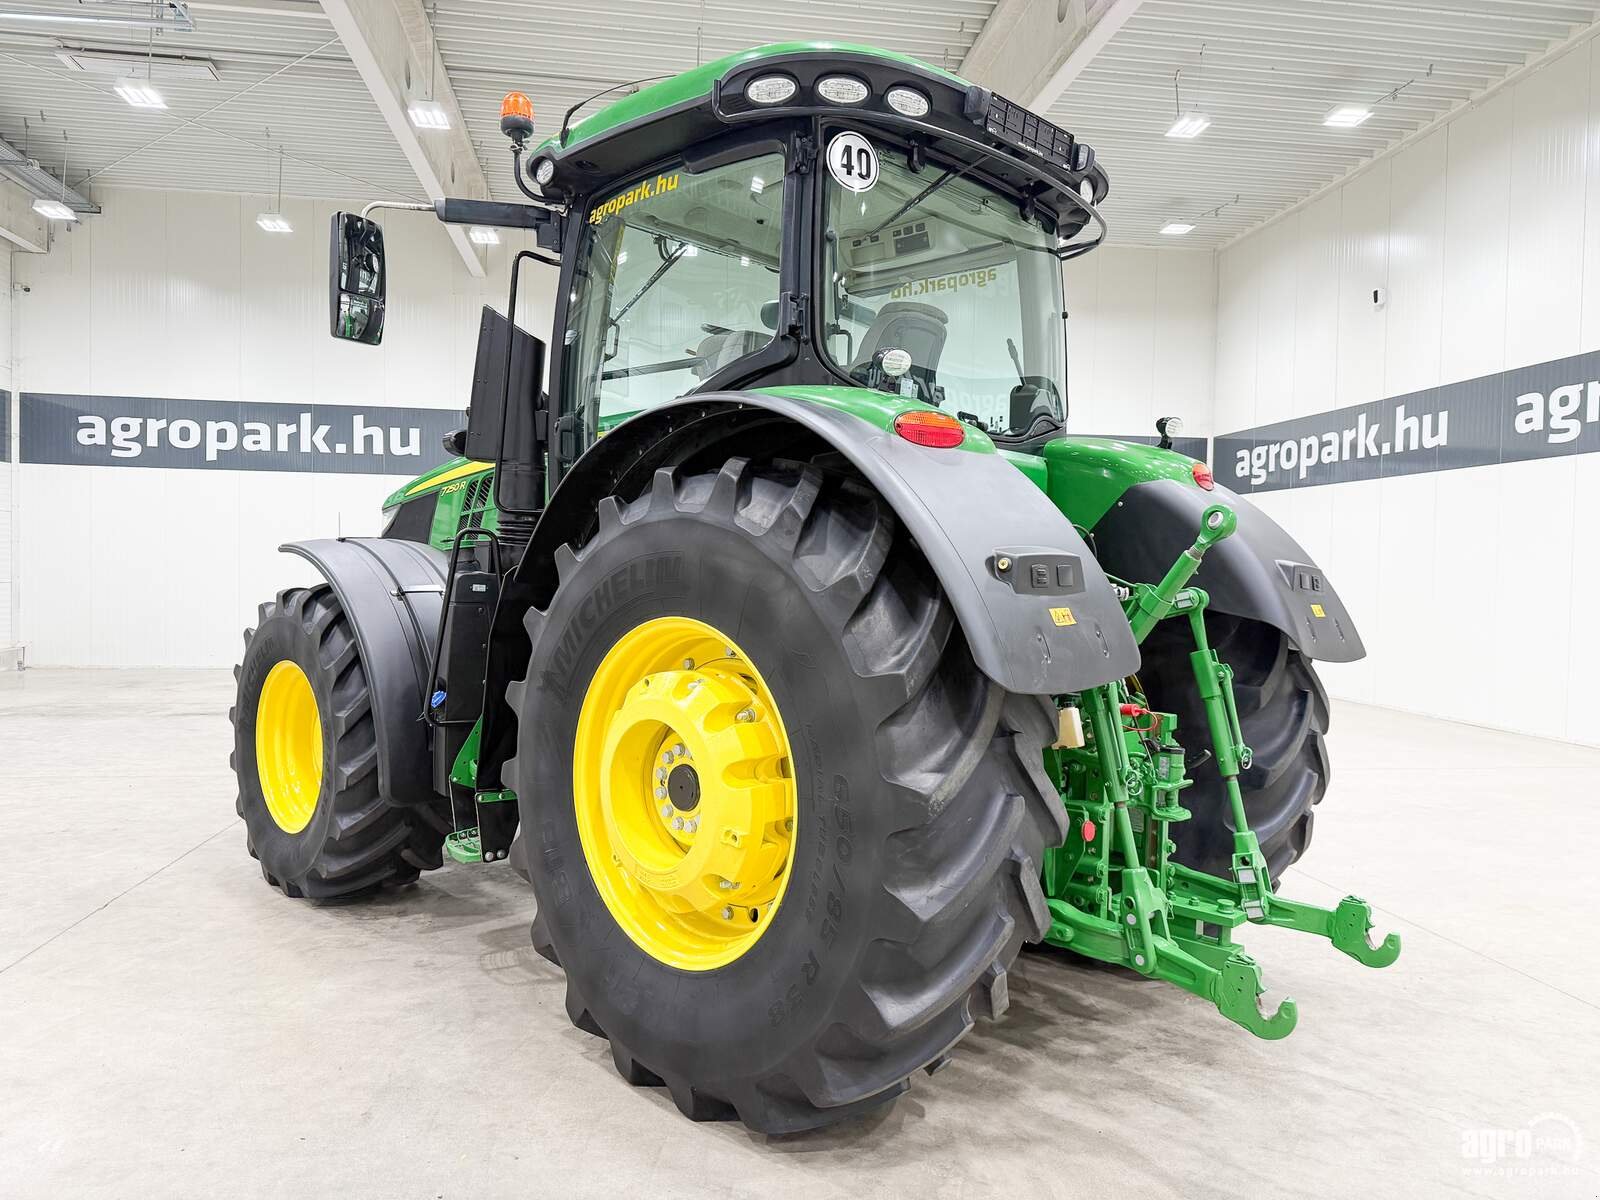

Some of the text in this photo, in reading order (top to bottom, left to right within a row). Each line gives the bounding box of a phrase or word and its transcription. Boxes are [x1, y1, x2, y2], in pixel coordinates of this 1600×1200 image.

[839, 143, 872, 180] 40
[589, 173, 680, 225] agropark.hu
[76, 412, 421, 461] agropark.hu
[1235, 404, 1449, 486] agropark.hu
[541, 556, 682, 704] MICHELIN
